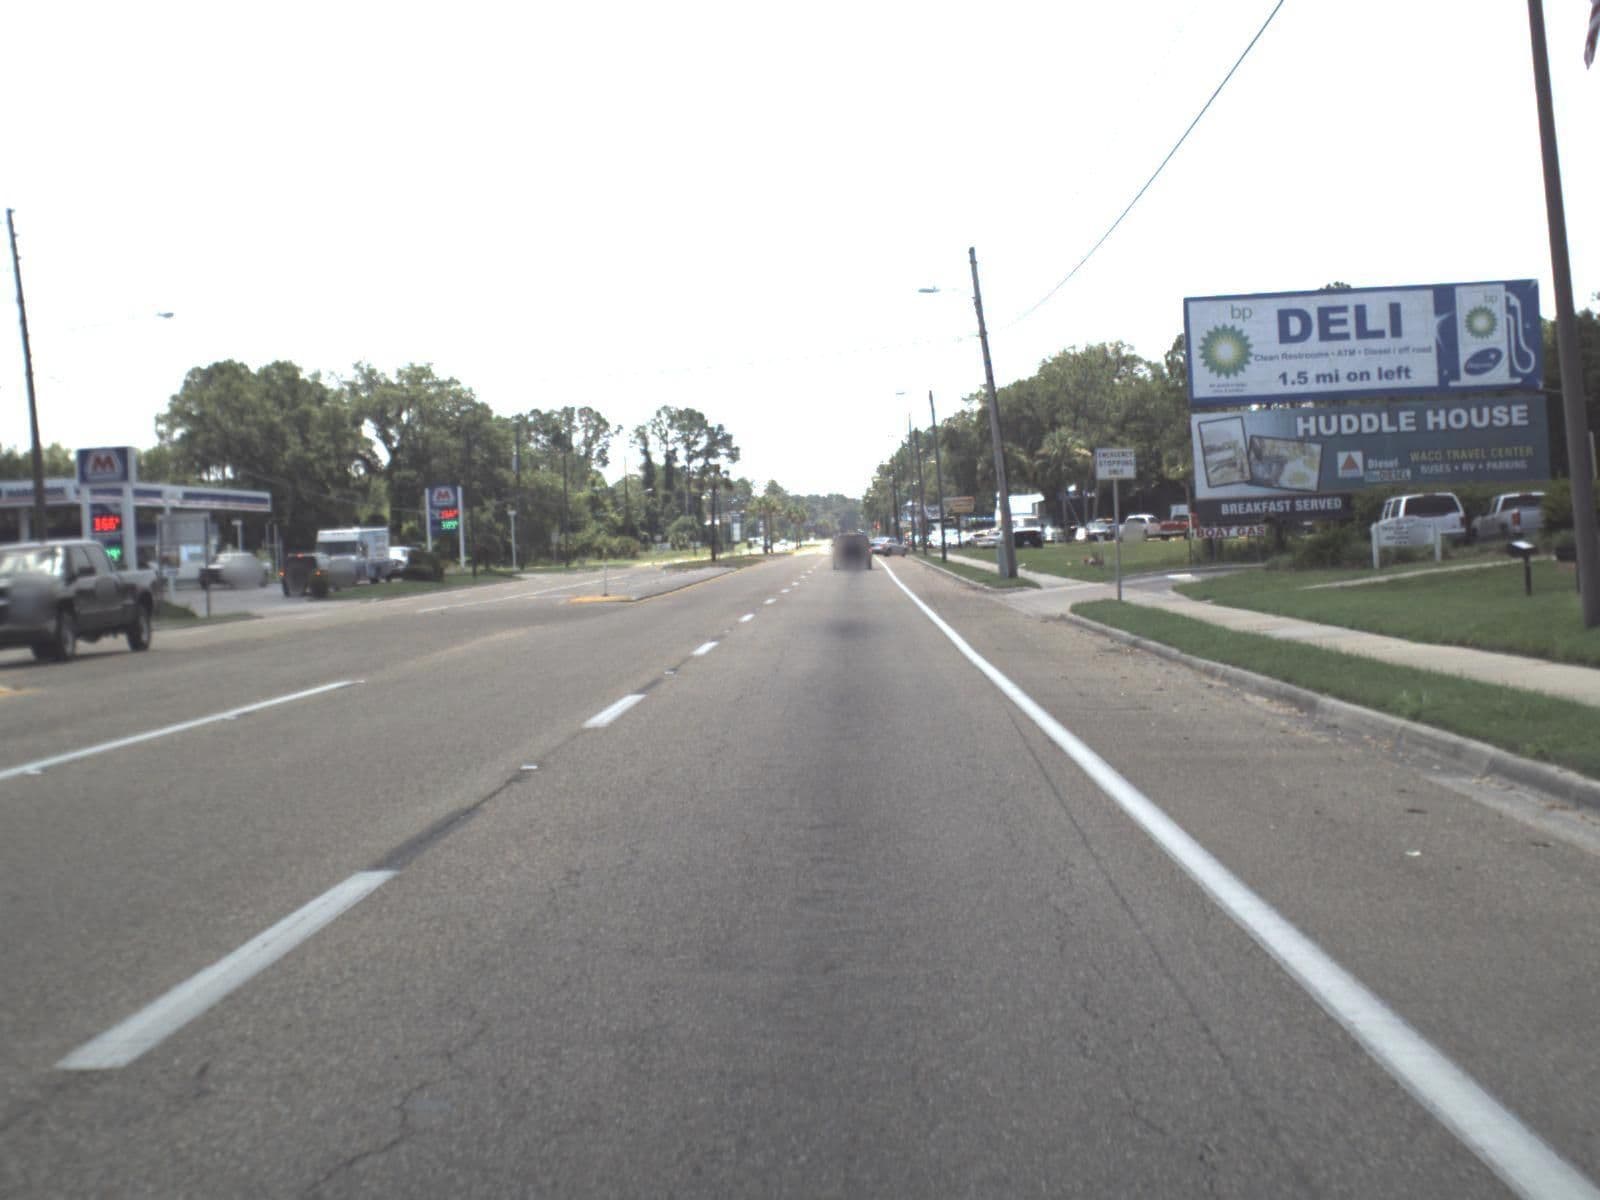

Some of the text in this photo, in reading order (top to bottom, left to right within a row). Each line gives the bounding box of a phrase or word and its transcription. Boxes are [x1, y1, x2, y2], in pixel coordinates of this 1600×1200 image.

[1230, 304, 1253, 323] bp
[1277, 302, 1403, 344] DELI
[1337, 348, 1356, 356] ATM
[1278, 365, 1411, 386] 1.5 mi on left
[1296, 405, 1529, 437] HUDDLE HOUSE
[1409, 446, 1534, 462] WACO TRAVEL CENTER
[1221, 498, 1342, 515] BREAKFAST SERVED
[1196, 526, 1265, 538] BOAT GAS
